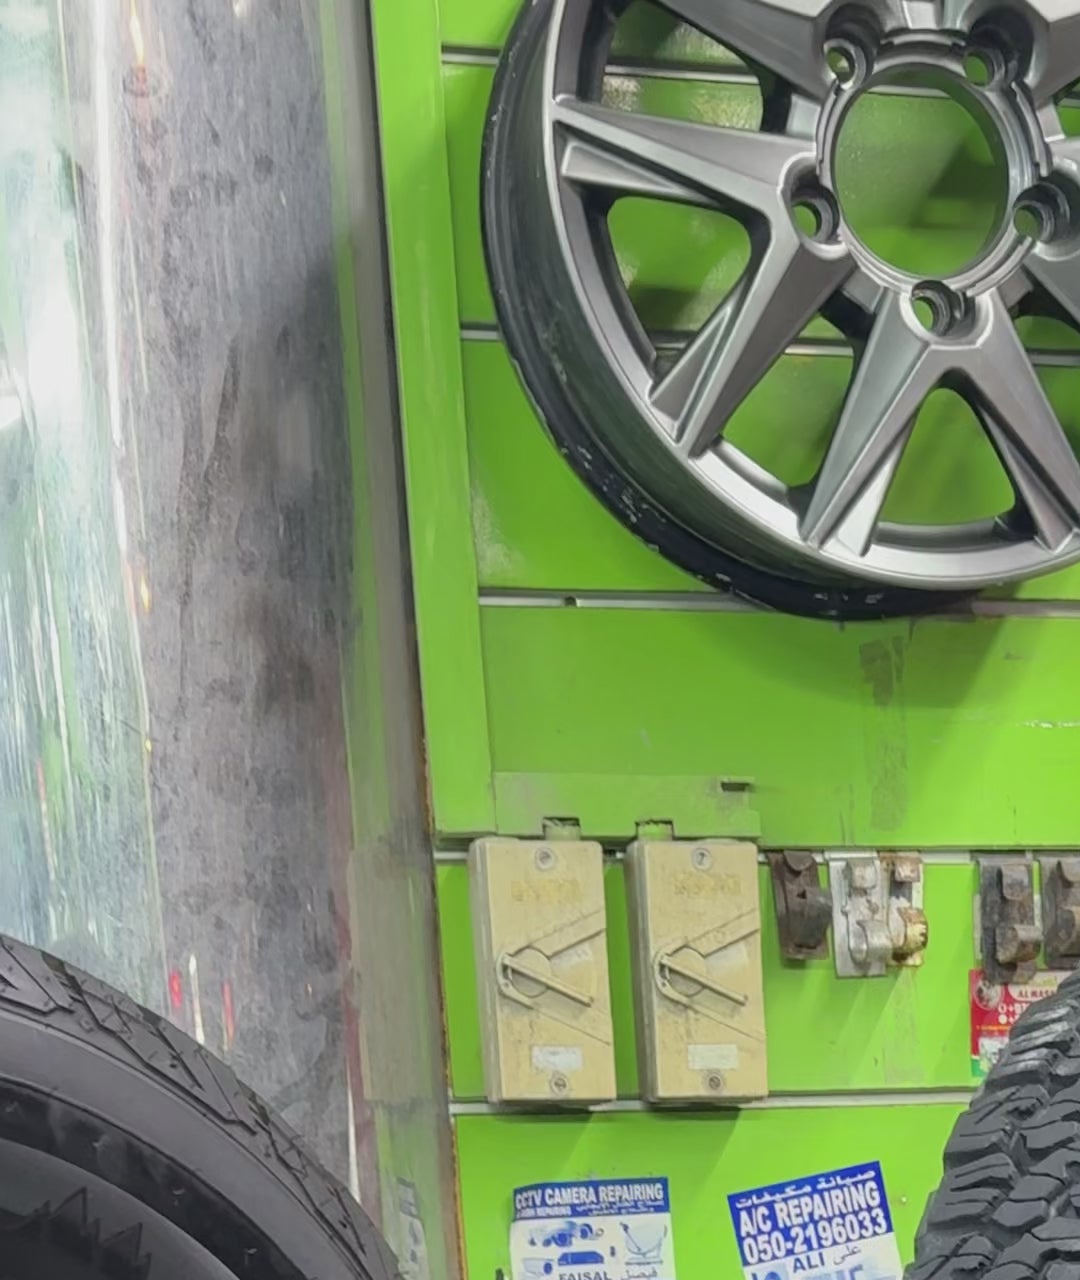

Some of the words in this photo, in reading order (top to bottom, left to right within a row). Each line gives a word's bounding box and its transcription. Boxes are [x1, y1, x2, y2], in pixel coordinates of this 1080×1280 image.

[515, 1189, 543, 1210] CCTV
[545, 1186, 597, 1206] CAMERA
[599, 1183, 664, 1203] REPAIRING
[740, 1206, 772, 1237] A/C
[774, 1180, 881, 1228] REPAIRING
[743, 1208, 888, 1265] 050-2196033
[793, 1252, 826, 1273] ALI
